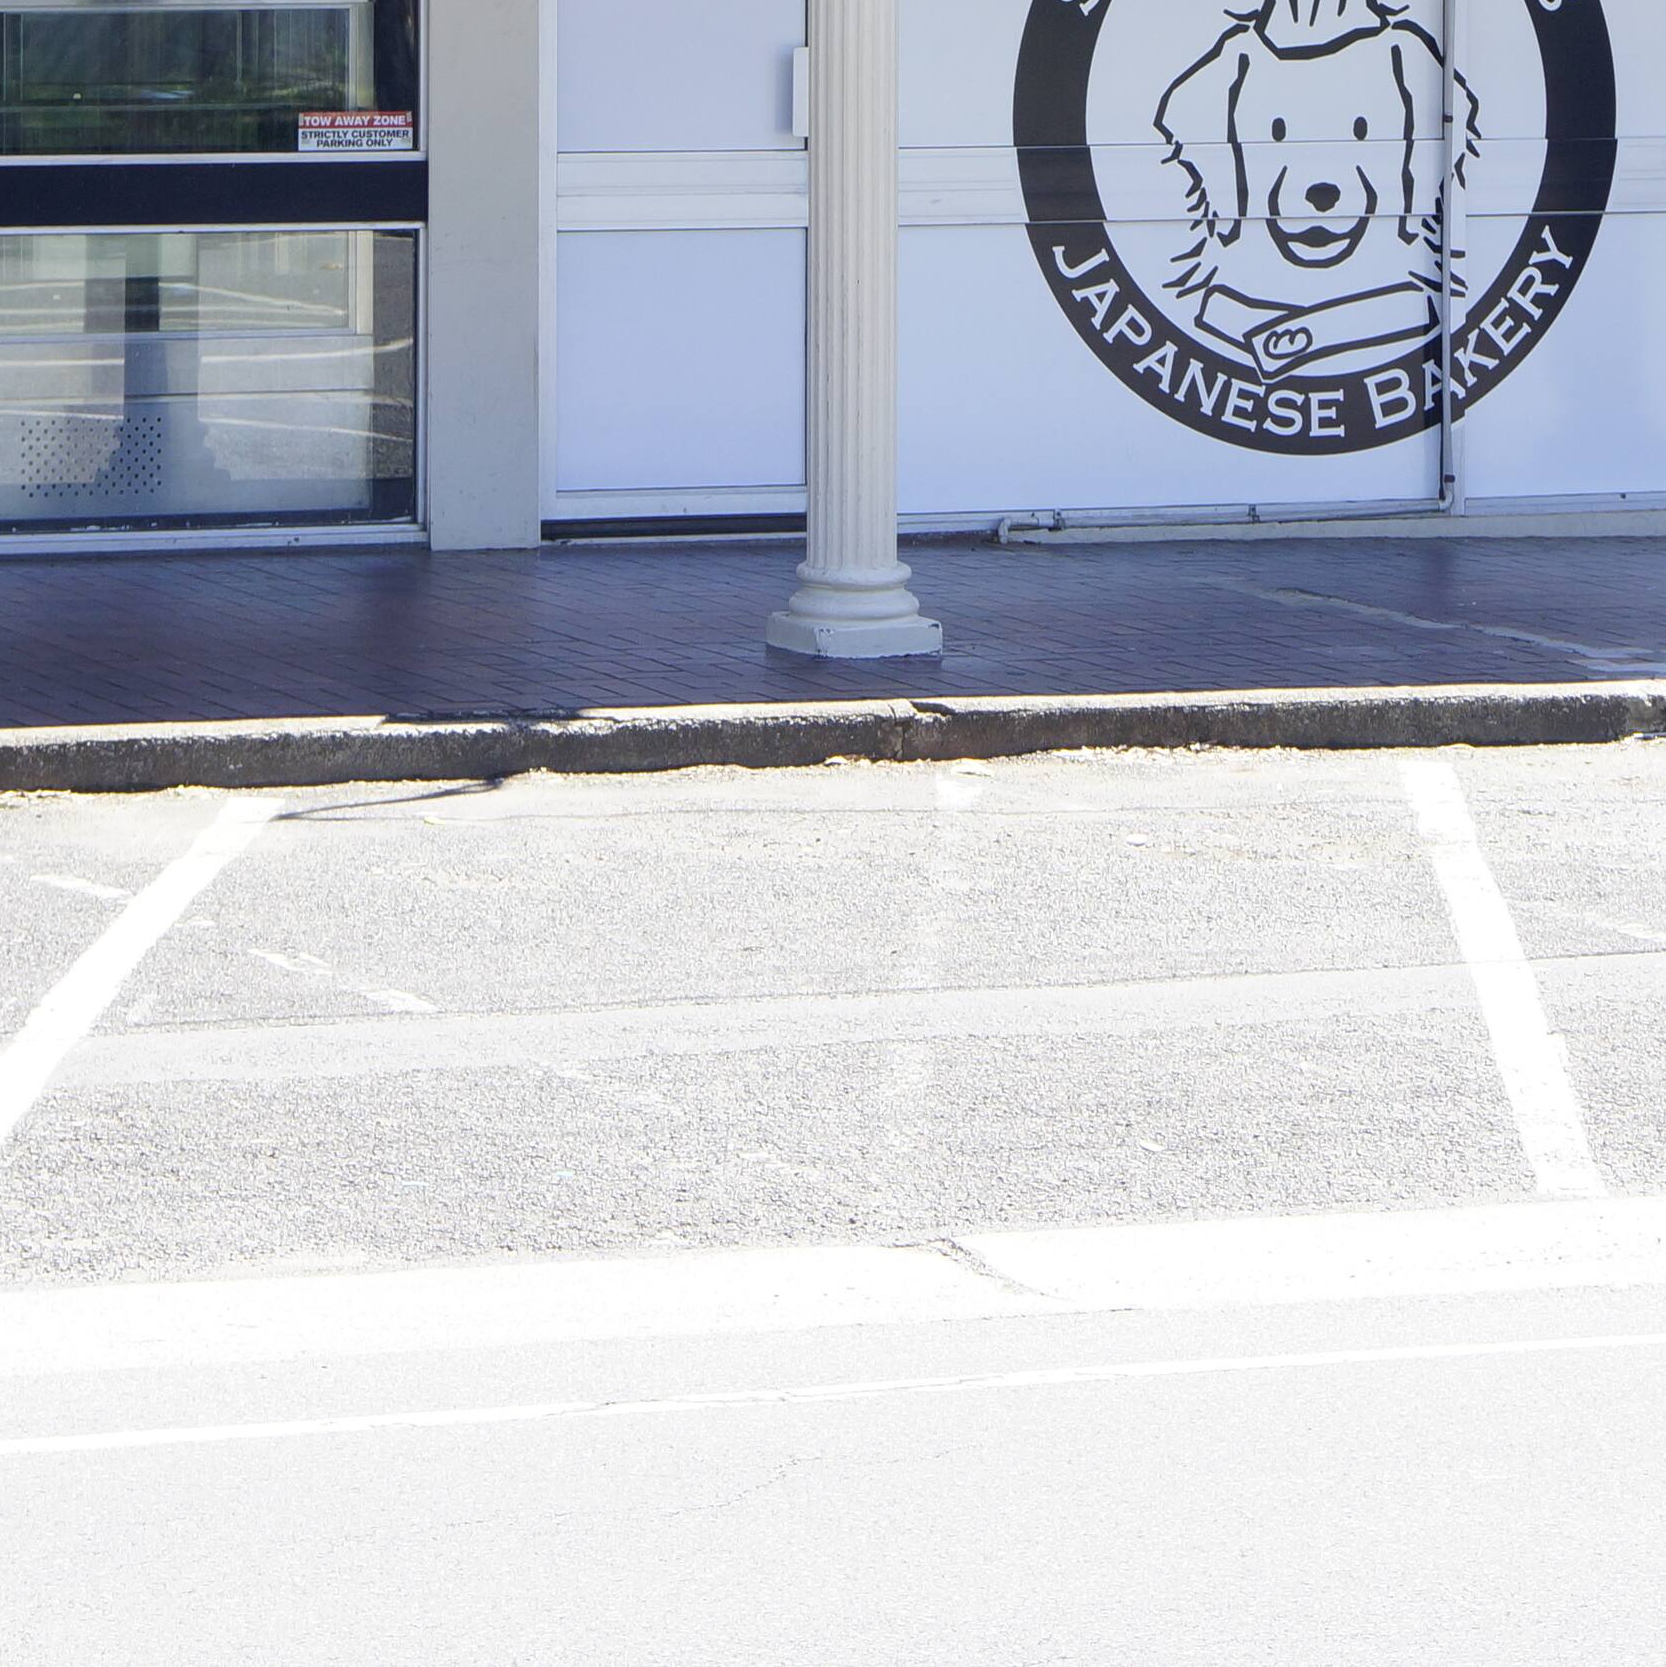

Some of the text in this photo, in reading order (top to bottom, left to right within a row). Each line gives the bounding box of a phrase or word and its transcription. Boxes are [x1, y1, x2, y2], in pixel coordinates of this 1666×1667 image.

[304, 114, 406, 127] TOW AWAY ZONE
[301, 129, 410, 140] STRICTLY CUSTOMER
[316, 138, 393, 148] PARKING ONLY
[1052, 223, 1575, 438] JAPANESE BAKERY
